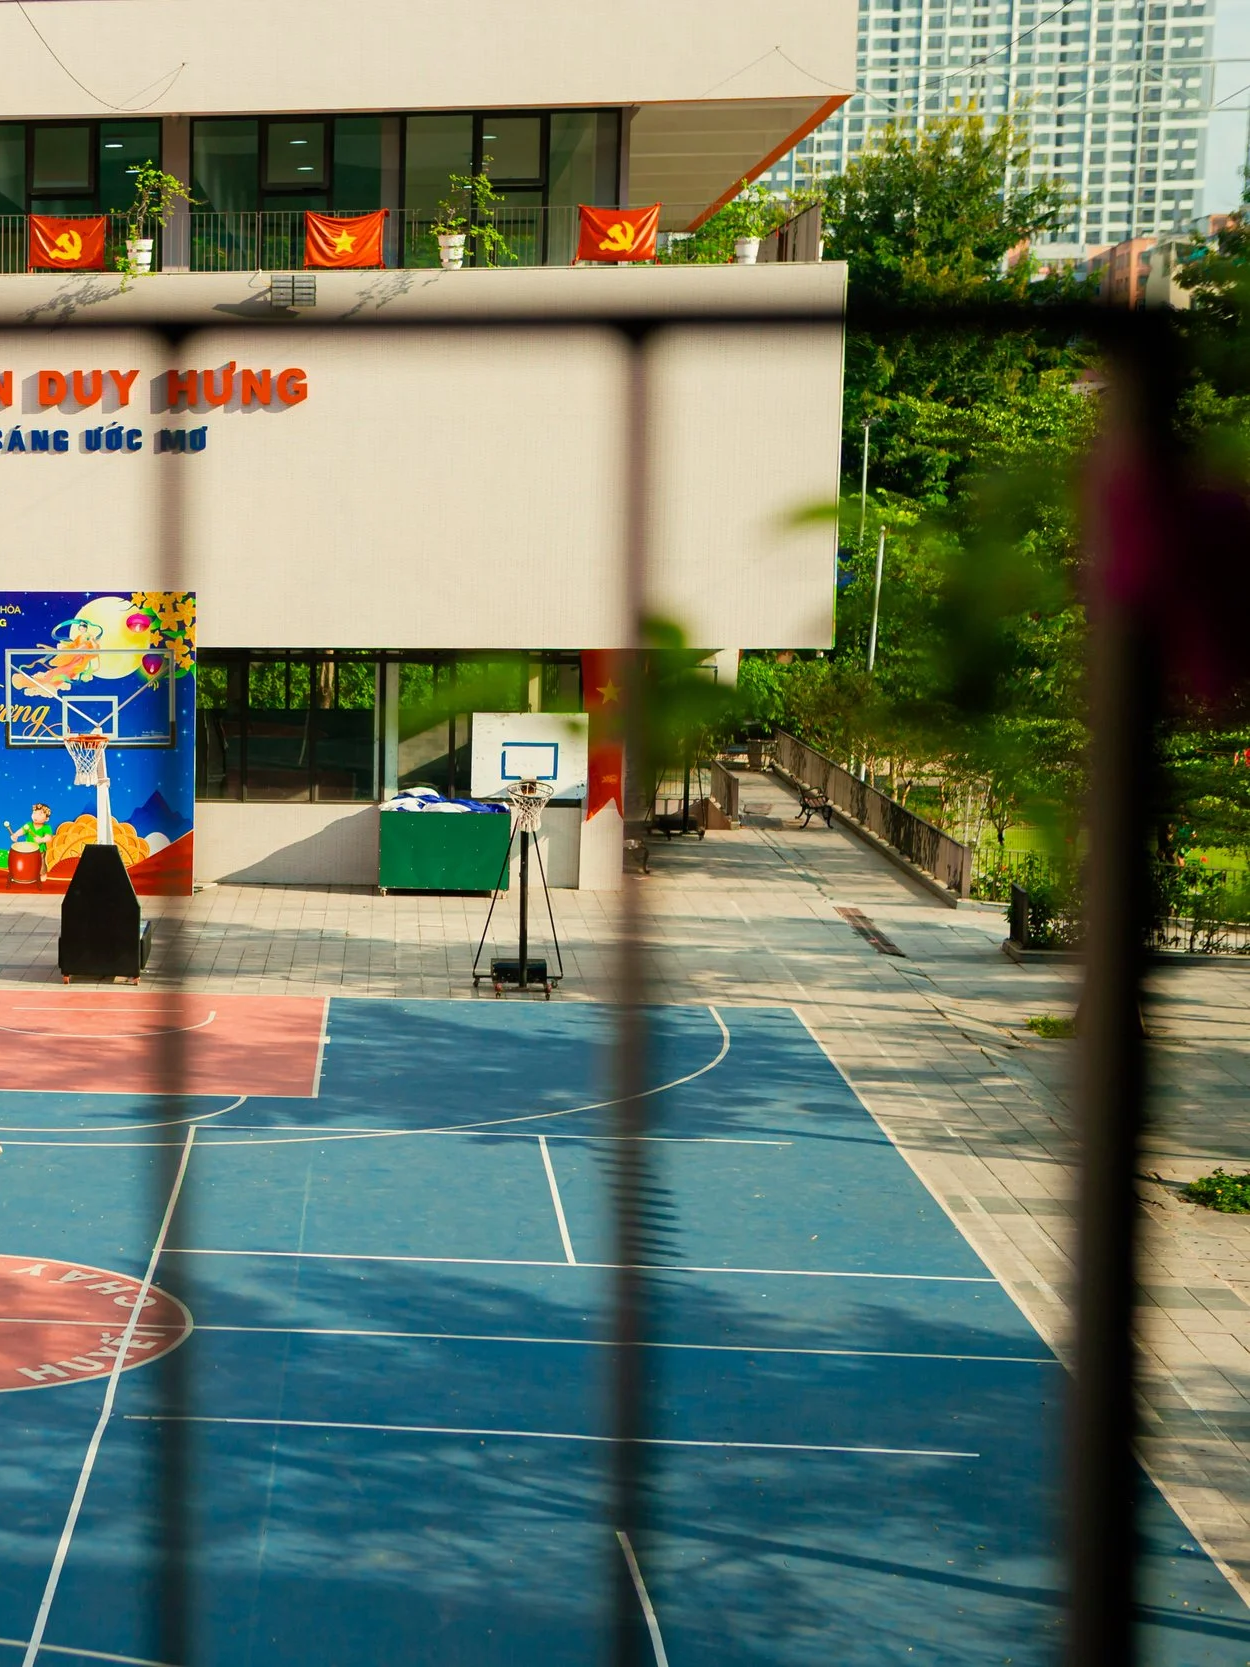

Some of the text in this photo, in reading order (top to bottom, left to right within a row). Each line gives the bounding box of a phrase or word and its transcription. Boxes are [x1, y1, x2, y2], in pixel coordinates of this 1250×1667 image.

[38, 369, 140, 406] DUY
[167, 361, 308, 406] HƯNG
[85, 421, 143, 452] ƯỚC
[160, 426, 208, 451] MƠ
[0, 603, 22, 614] HÒA
